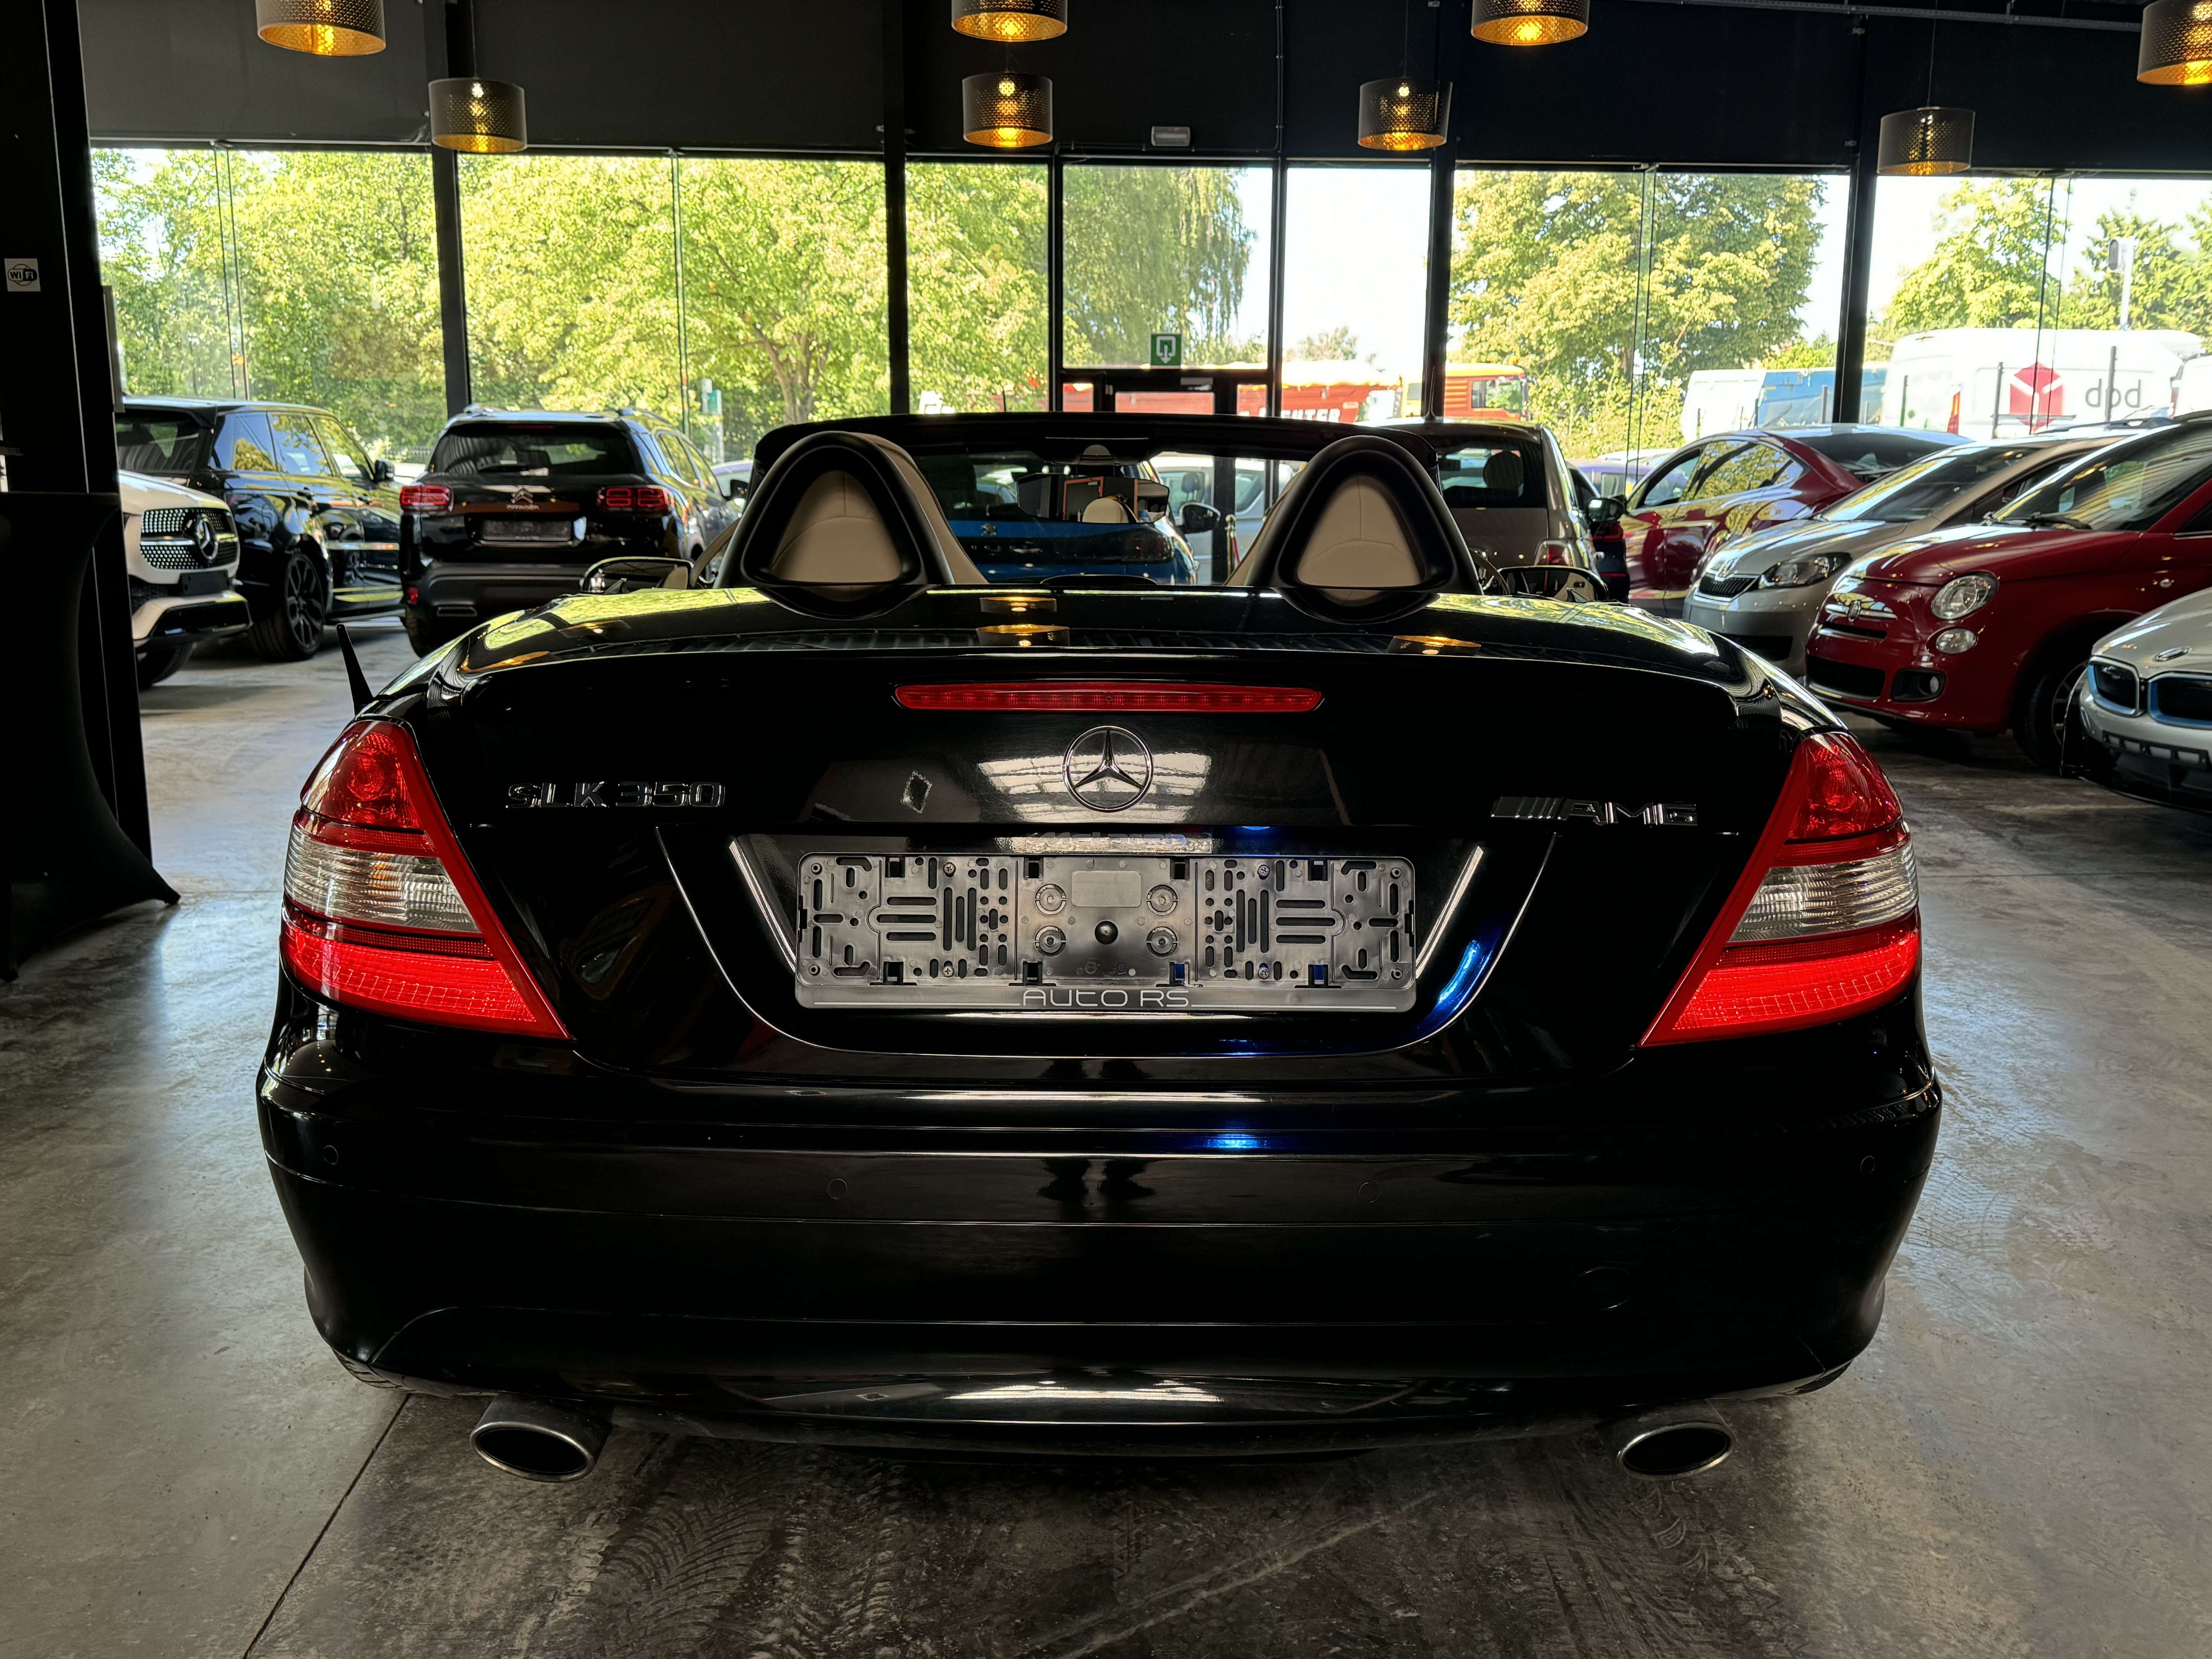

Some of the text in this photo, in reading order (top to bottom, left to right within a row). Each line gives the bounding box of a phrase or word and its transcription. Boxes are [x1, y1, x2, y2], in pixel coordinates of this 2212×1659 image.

[505, 781, 725, 808] SLK 350
[1556, 799, 1698, 826] AMG
[1140, 990, 1189, 1007] RS
